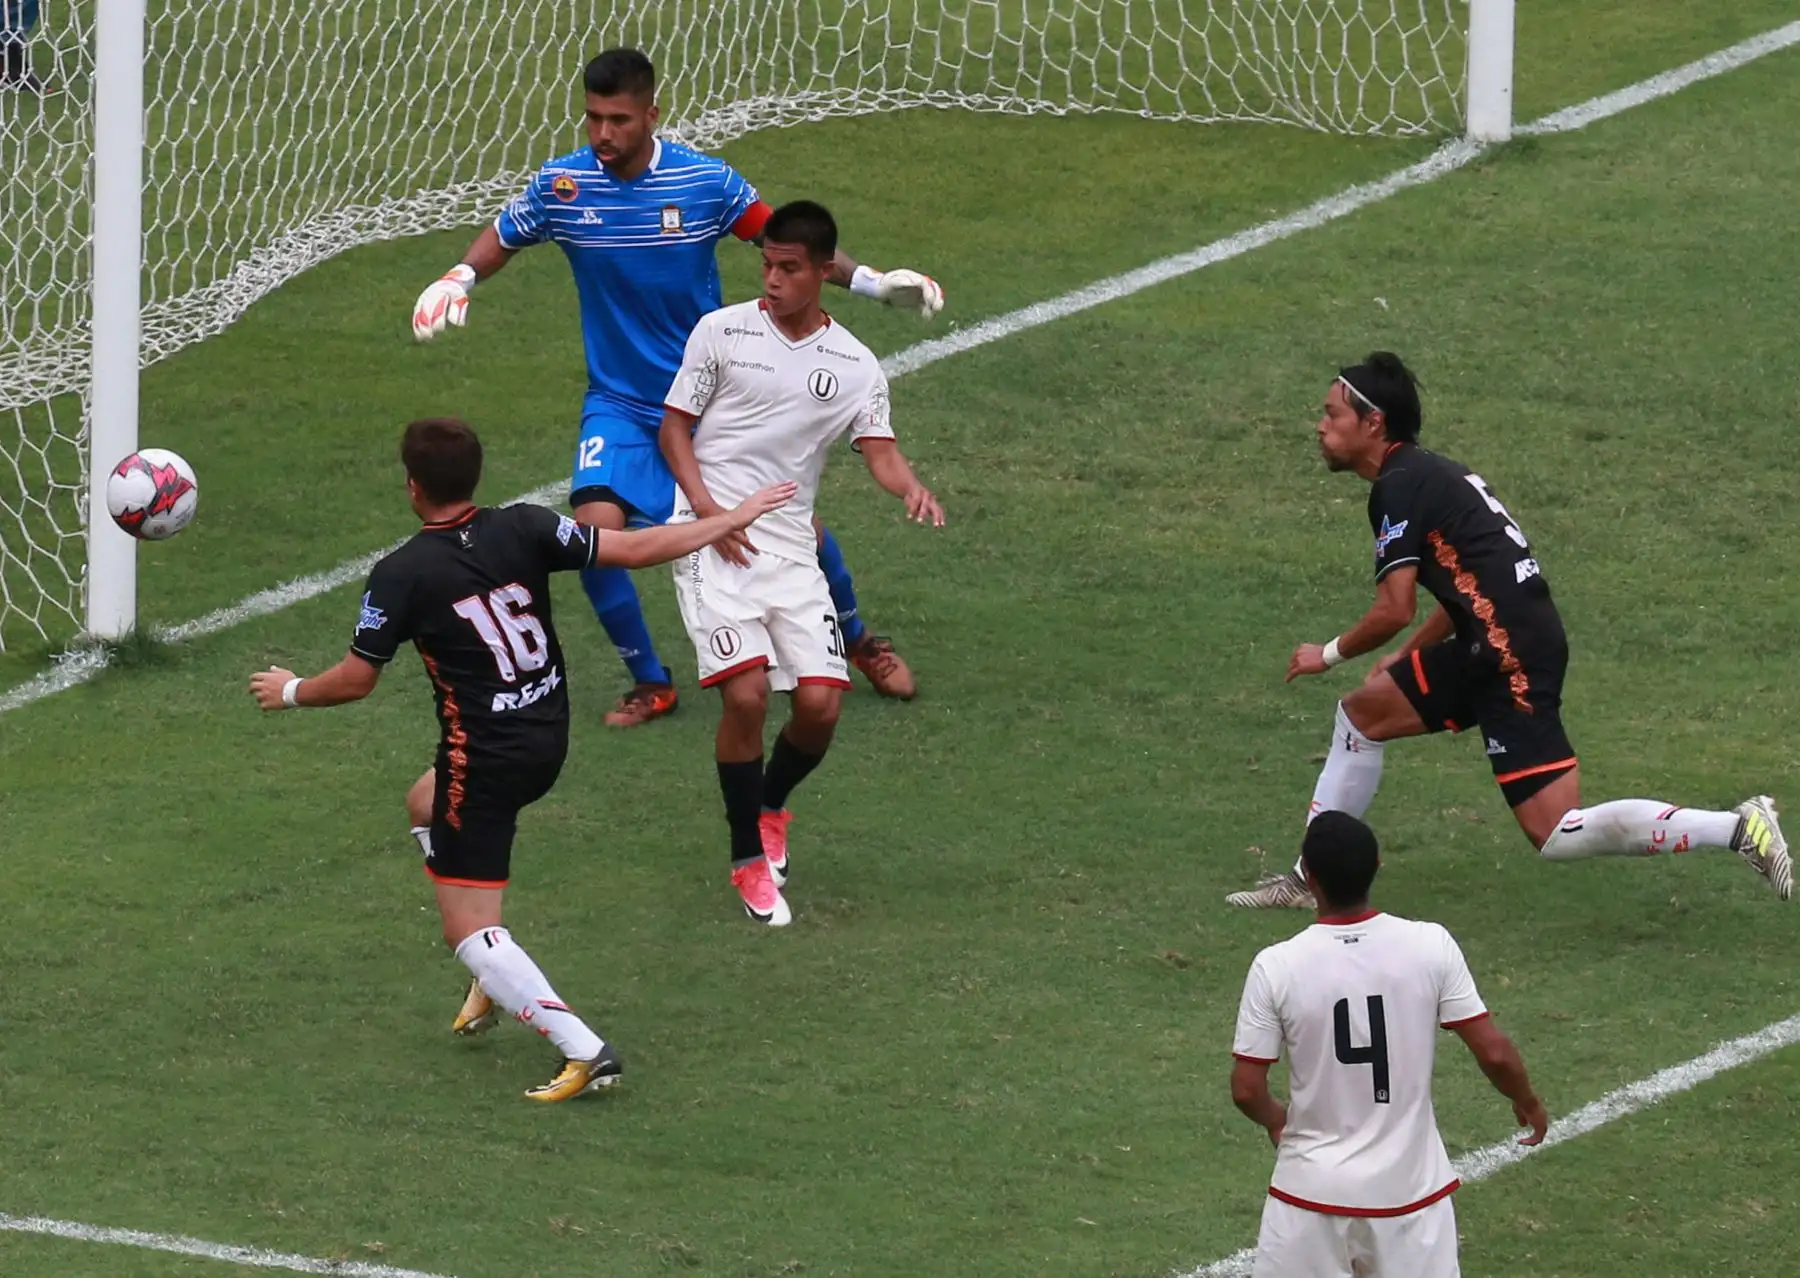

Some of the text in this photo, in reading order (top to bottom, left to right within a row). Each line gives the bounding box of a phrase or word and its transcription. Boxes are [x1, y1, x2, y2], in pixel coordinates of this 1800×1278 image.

[730, 359, 775, 374] marathon
[815, 372, 831, 398] U
[579, 435, 605, 471] 12
[1463, 473, 1528, 549] 5
[452, 581, 549, 684] 16
[714, 631, 735, 656] U
[1333, 994, 1390, 1104] 4
